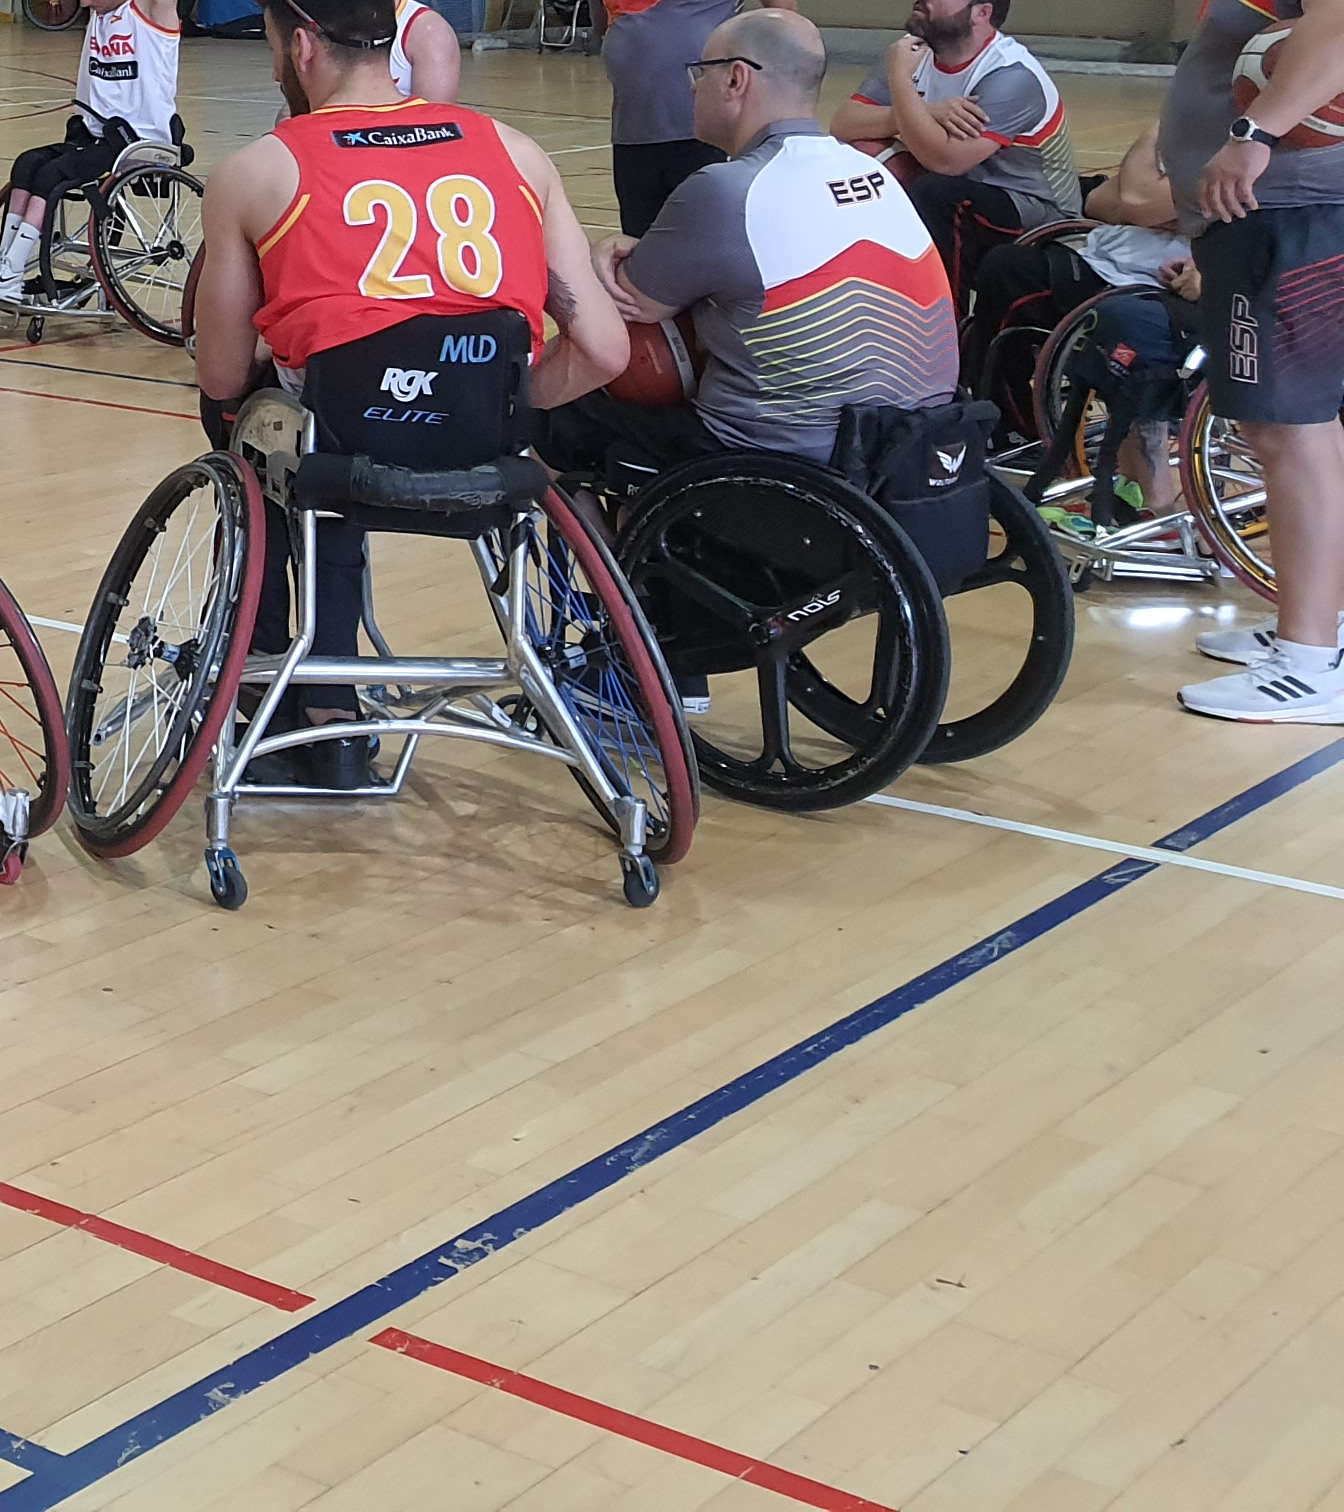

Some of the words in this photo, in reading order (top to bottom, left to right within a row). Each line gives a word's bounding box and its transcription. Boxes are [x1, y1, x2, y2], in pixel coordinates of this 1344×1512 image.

[368, 127, 455, 145] CaixaBank
[826, 170, 885, 207] ESP
[342, 174, 503, 299] 28
[1229, 293, 1259, 384] ESP
[363, 406, 449, 425] ELITE
